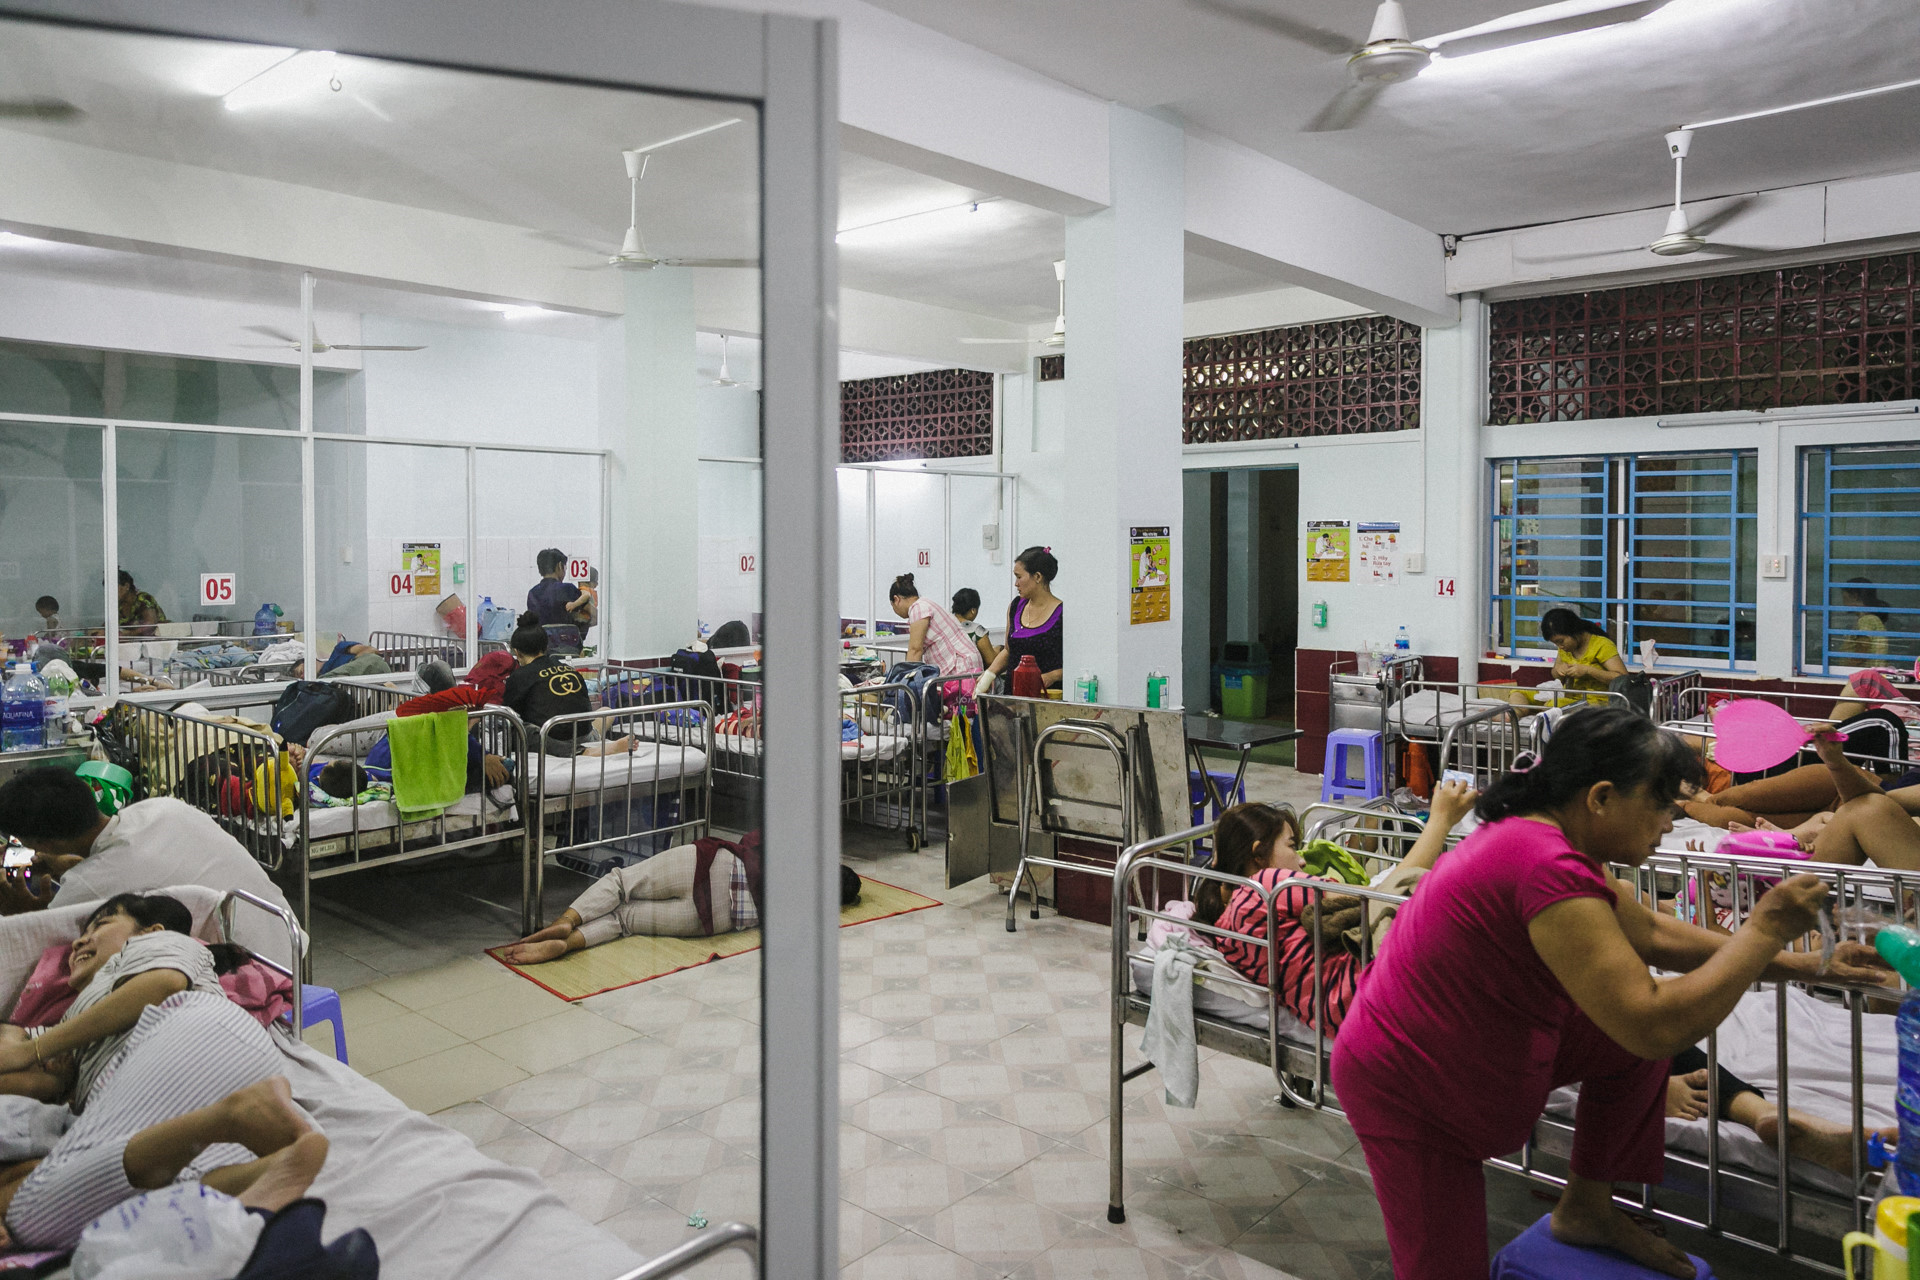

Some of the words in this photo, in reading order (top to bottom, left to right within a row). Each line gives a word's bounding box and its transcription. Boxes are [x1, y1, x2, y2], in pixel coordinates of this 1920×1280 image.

[740, 555, 755, 572] 02
[918, 551, 930, 566] 01
[570, 560, 588, 578] 03
[205, 579, 232, 601] 05
[391, 574, 412, 594] 04
[1437, 579, 1455, 596] 14
[2, 710, 35, 720] AQUAFINA
